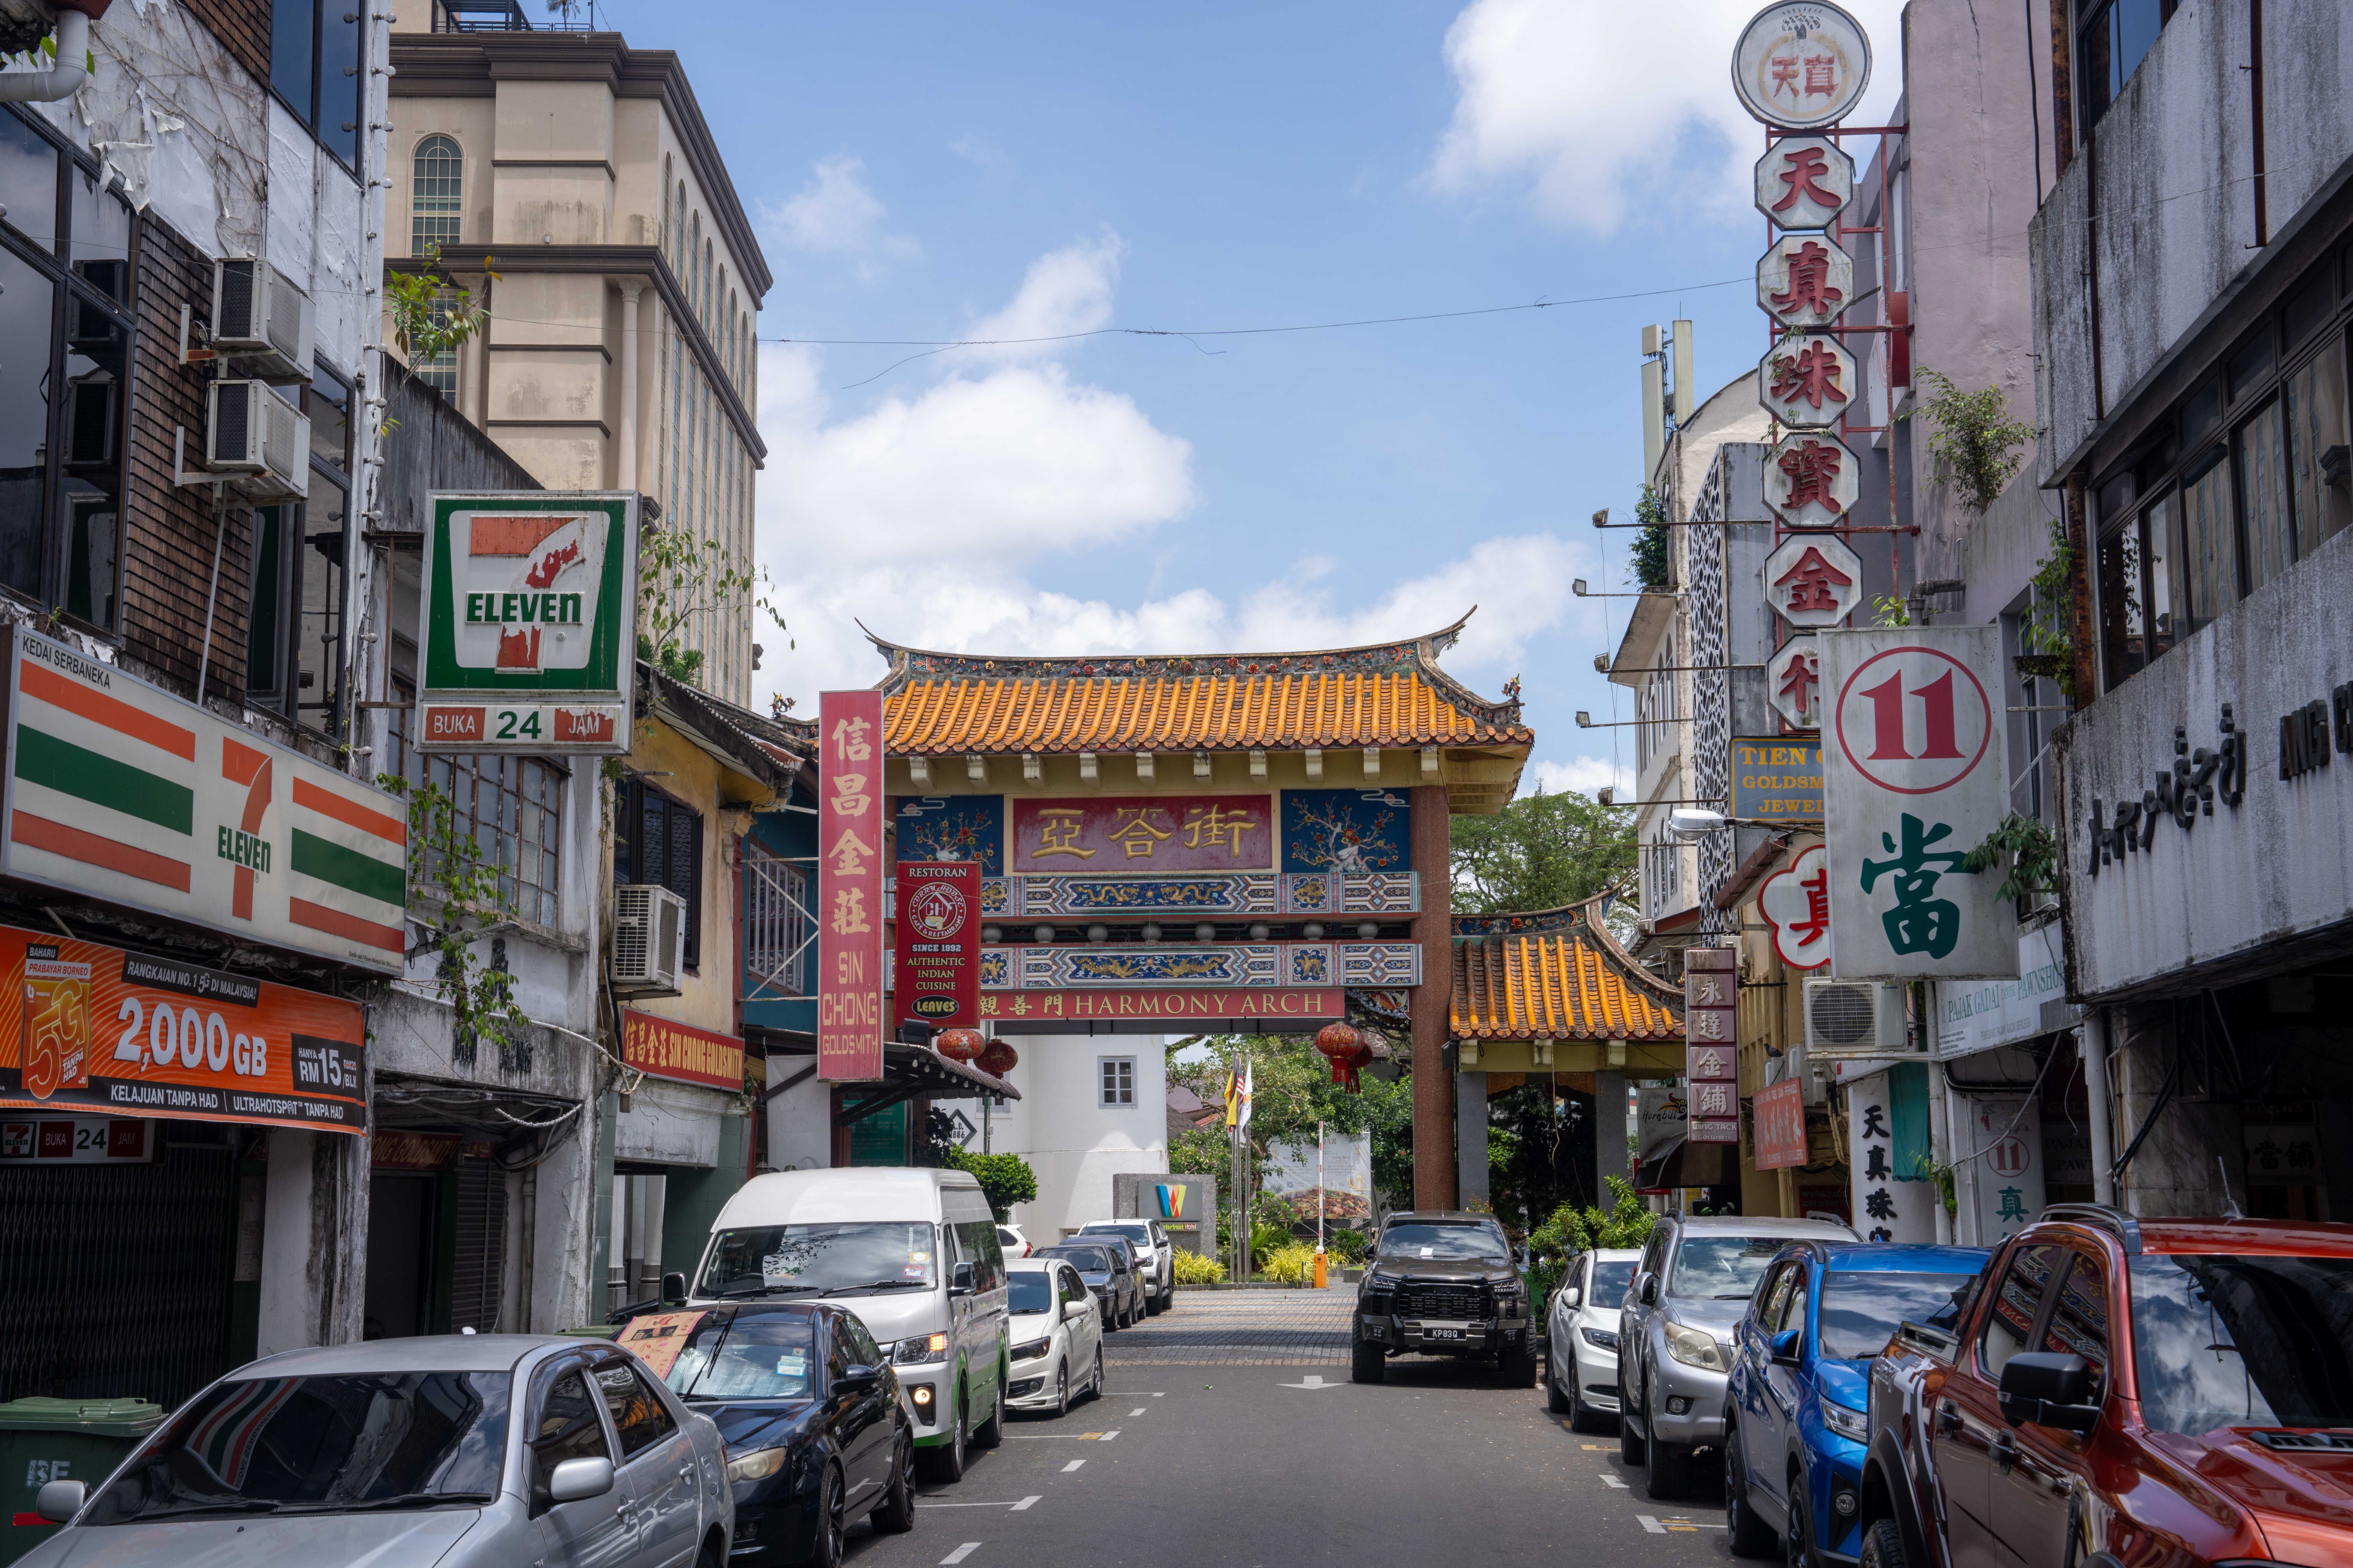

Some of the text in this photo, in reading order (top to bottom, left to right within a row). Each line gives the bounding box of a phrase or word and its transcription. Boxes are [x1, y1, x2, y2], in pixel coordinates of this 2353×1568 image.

[1771, 54, 1838, 98] 天真
[23, 636, 110, 689] KEDAI SERBANEKA
[434, 711, 599, 739] BUKA 24 JAM
[1859, 669, 1965, 759] 11
[2279, 699, 2330, 781] ANG
[1739, 748, 1807, 765] TIEN
[909, 868, 967, 877] RESTORAN
[912, 884, 964, 908] CURRY HOUSE
[1860, 813, 1981, 959] 當
[925, 902, 944, 916] CH
[912, 915, 924, 933] CAFÉ
[928, 915, 963, 937] RESTAURANT
[30, 947, 55, 958] BAHARU
[907, 958, 966, 966] AUTHENTIC
[28, 963, 88, 976] PRABAYAR BORNEO
[838, 951, 863, 984] SIN
[917, 969, 955, 978] INDIAN
[128, 961, 256, 1000] RANGKAIAN NO. 1 5G DI MALAYSIA!
[916, 982, 956, 990] CUISINE
[1948, 994, 1973, 1022] PAJAK
[1974, 984, 2000, 1014] GADAI
[2001, 985, 2016, 1000] CANTIK
[2018, 961, 2065, 1001] PAWNSHOP
[823, 993, 877, 1025] CHONG
[916, 1001, 955, 1012] LEAVES
[980, 994, 1063, 1017] 親善門
[1075, 993, 1323, 1014] HARMONY ARCH
[113, 997, 267, 1076] 2,000 GB
[823, 1034, 878, 1055] GOLDSMITH
[62, 1049, 84, 1070] TANPA
[299, 1047, 317, 1060] HANYA
[669, 1032, 742, 1080] SIN CHONG GOLDSMITH
[63, 1066, 77, 1084] HAD
[111, 1085, 166, 1103] KELAJUAN
[166, 1090, 198, 1106] TANPA
[199, 1093, 218, 1109] HAD
[304, 1102, 329, 1118] TANPA
[330, 1105, 343, 1119] HAD
[1643, 1109, 1678, 1123] Hornbill
[46, 1128, 134, 1149] BUKA 24 JAM
[371, 1136, 397, 1163] ONG
[1995, 1142, 2022, 1170] 11
[1433, 1330, 1458, 1338] KP83Q
